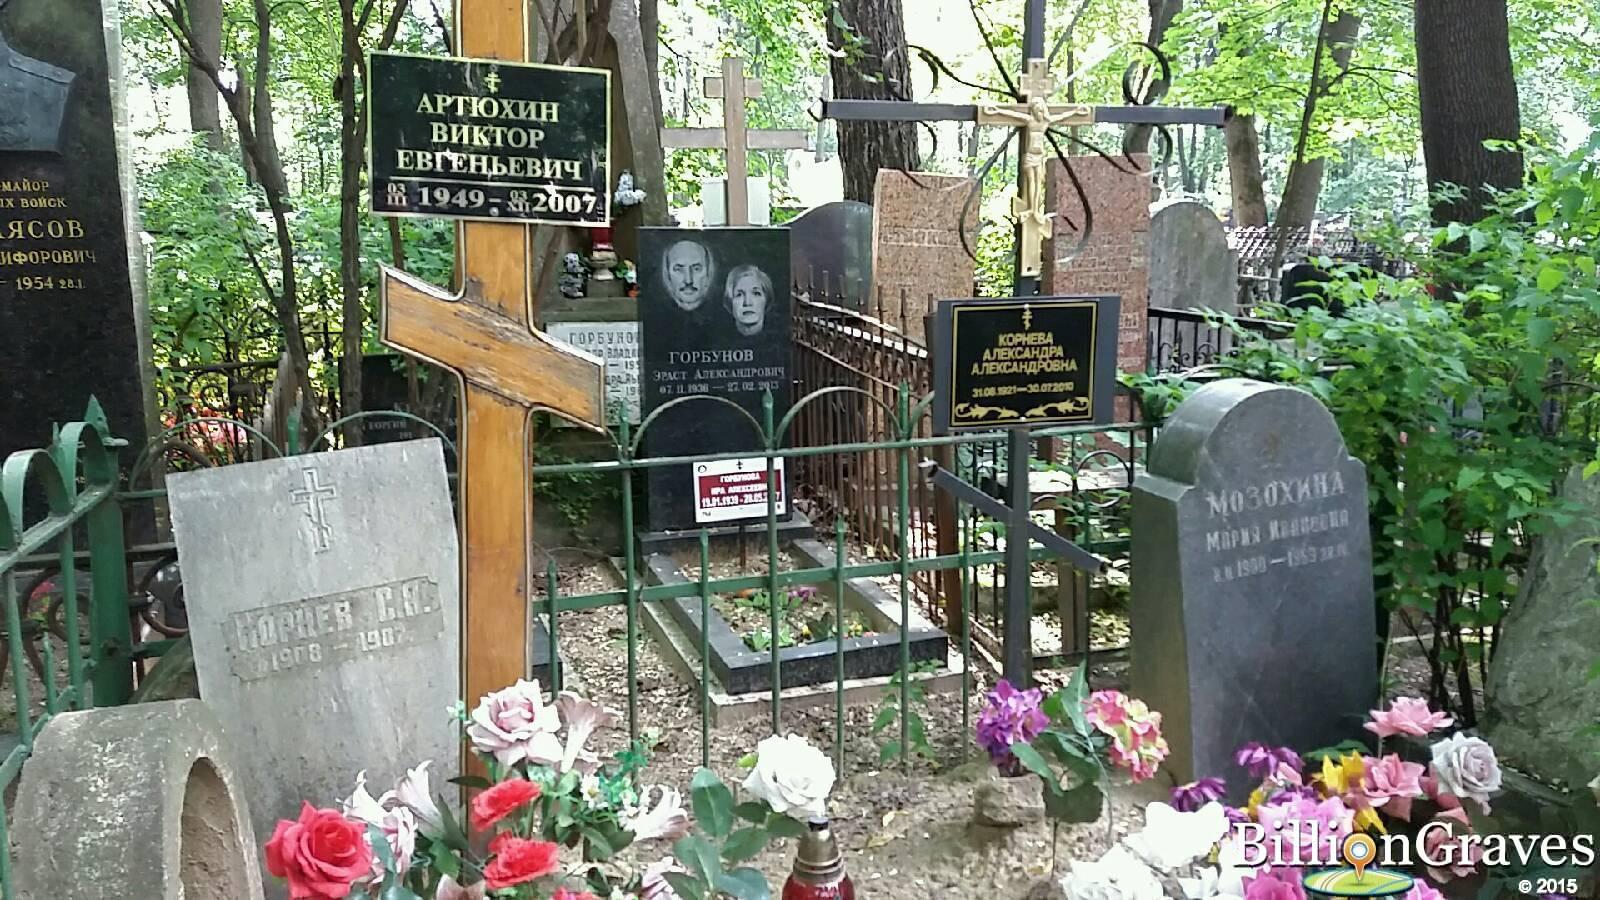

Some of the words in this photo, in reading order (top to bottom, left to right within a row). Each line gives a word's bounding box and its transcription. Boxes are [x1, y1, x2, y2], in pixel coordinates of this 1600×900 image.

[417, 93, 560, 123] АРТЮХИН
[430, 122, 546, 149] ВИКТОР
[396, 149, 583, 181] ЕВГЕНЬЕВИЧ
[387, 182, 406, 193] 03
[21, 197, 67, 208] ВОЙСК
[418, 187, 485, 208] 1949
[532, 192, 597, 214] 2007
[0, 220, 84, 239] ЯСОВ
[16, 276, 54, 290] 1954
[999, 332, 1053, 346] КОРНЕВА
[669, 350, 754, 364] ГОРБУНОВ
[983, 346, 1064, 361] АЛЕКСАНДРА
[653, 370, 687, 382] ЭРАСТ
[694, 366, 785, 381] АЛЕКСАНДРОВИЧ
[971, 358, 1078, 376] АЛЕКСАНДРОВНА
[1205, 471, 1346, 519] МОЗОХИНА
